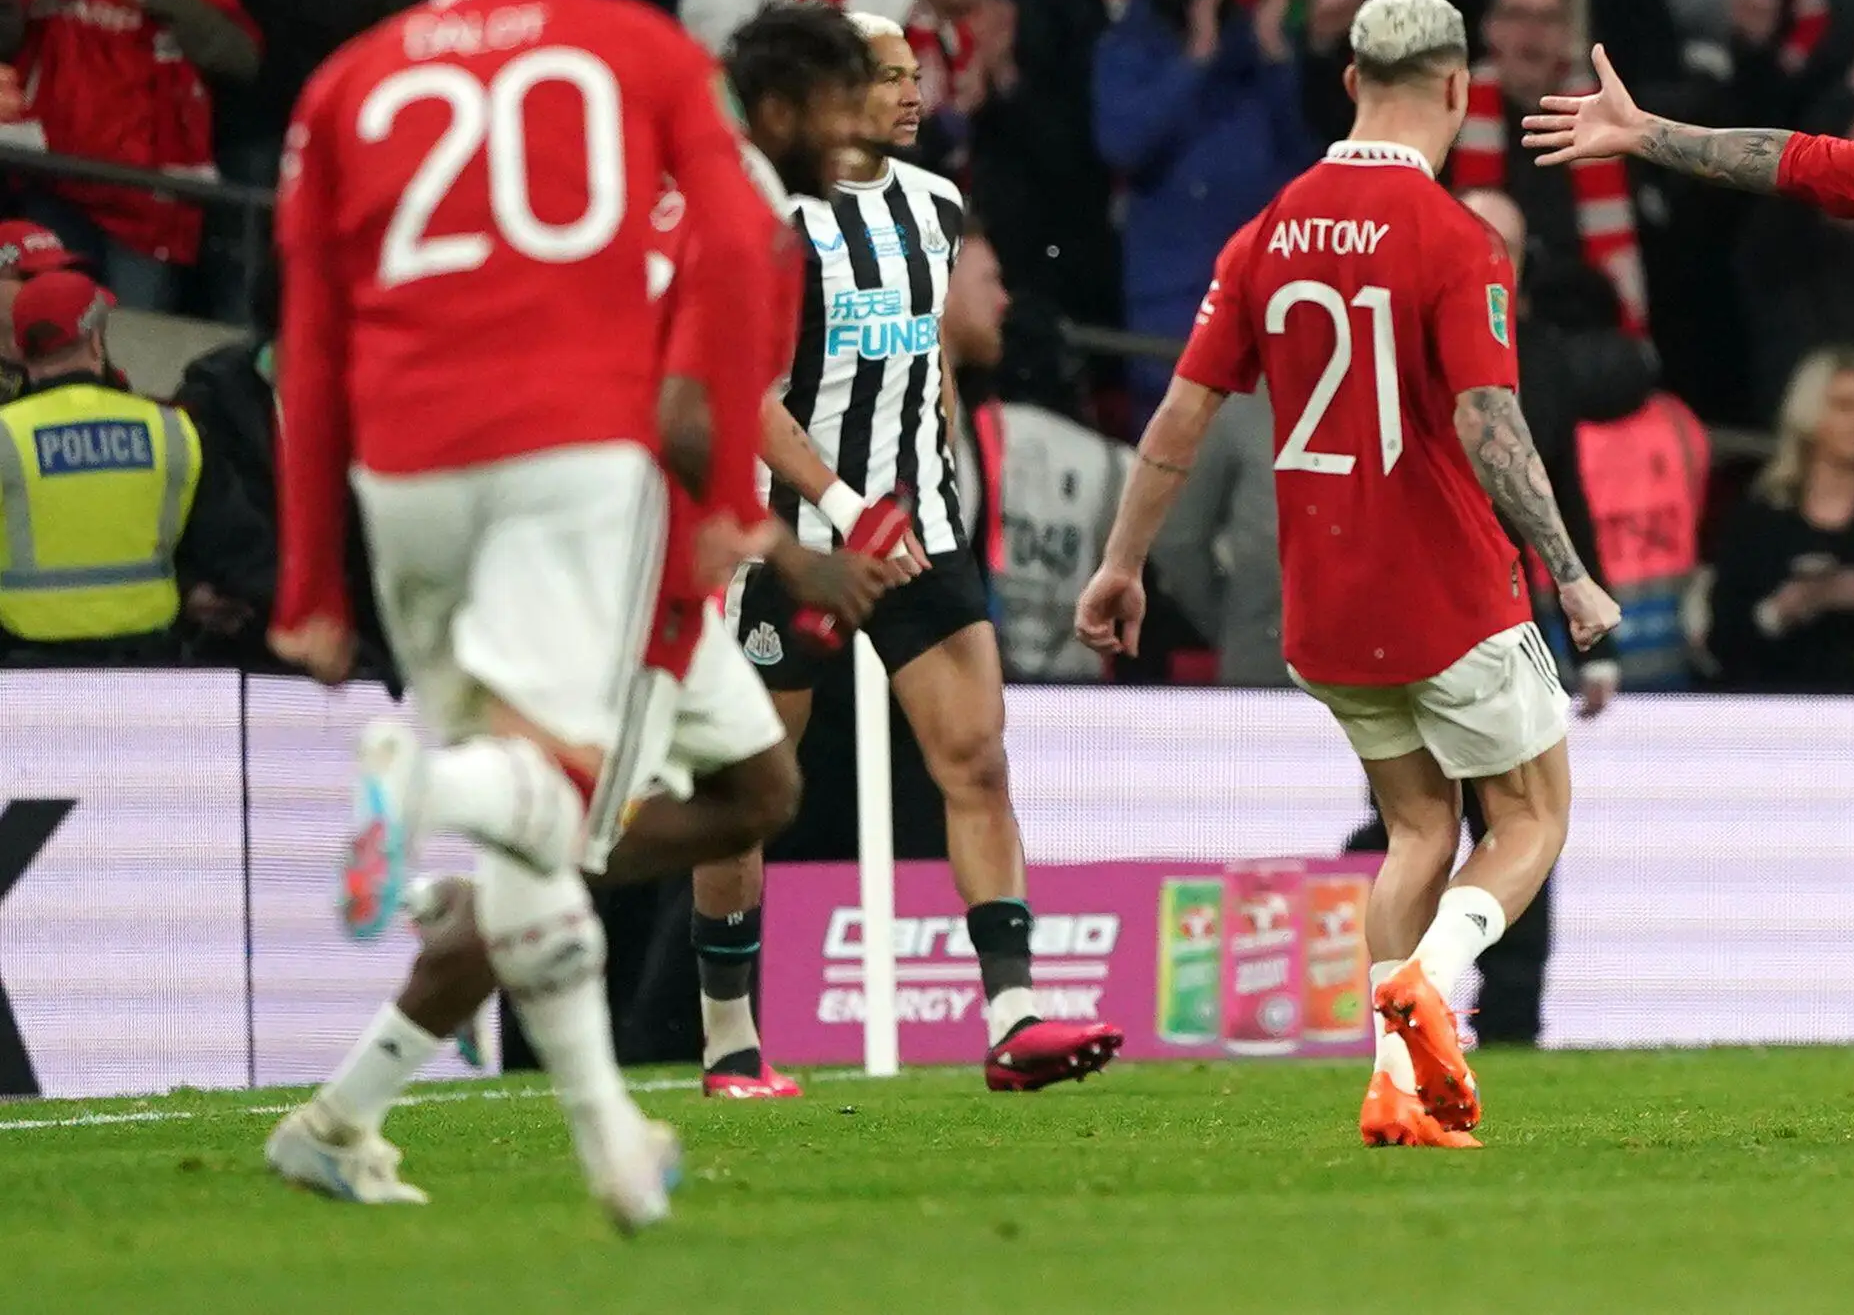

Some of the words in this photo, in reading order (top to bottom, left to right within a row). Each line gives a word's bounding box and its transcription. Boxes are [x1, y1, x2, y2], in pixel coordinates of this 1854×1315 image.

[357, 46, 627, 291] 20
[1267, 218, 1390, 260] ANTONY
[1264, 279, 1404, 477] 21
[39, 425, 150, 469] POLICE
[817, 987, 977, 1023] ENRGY
